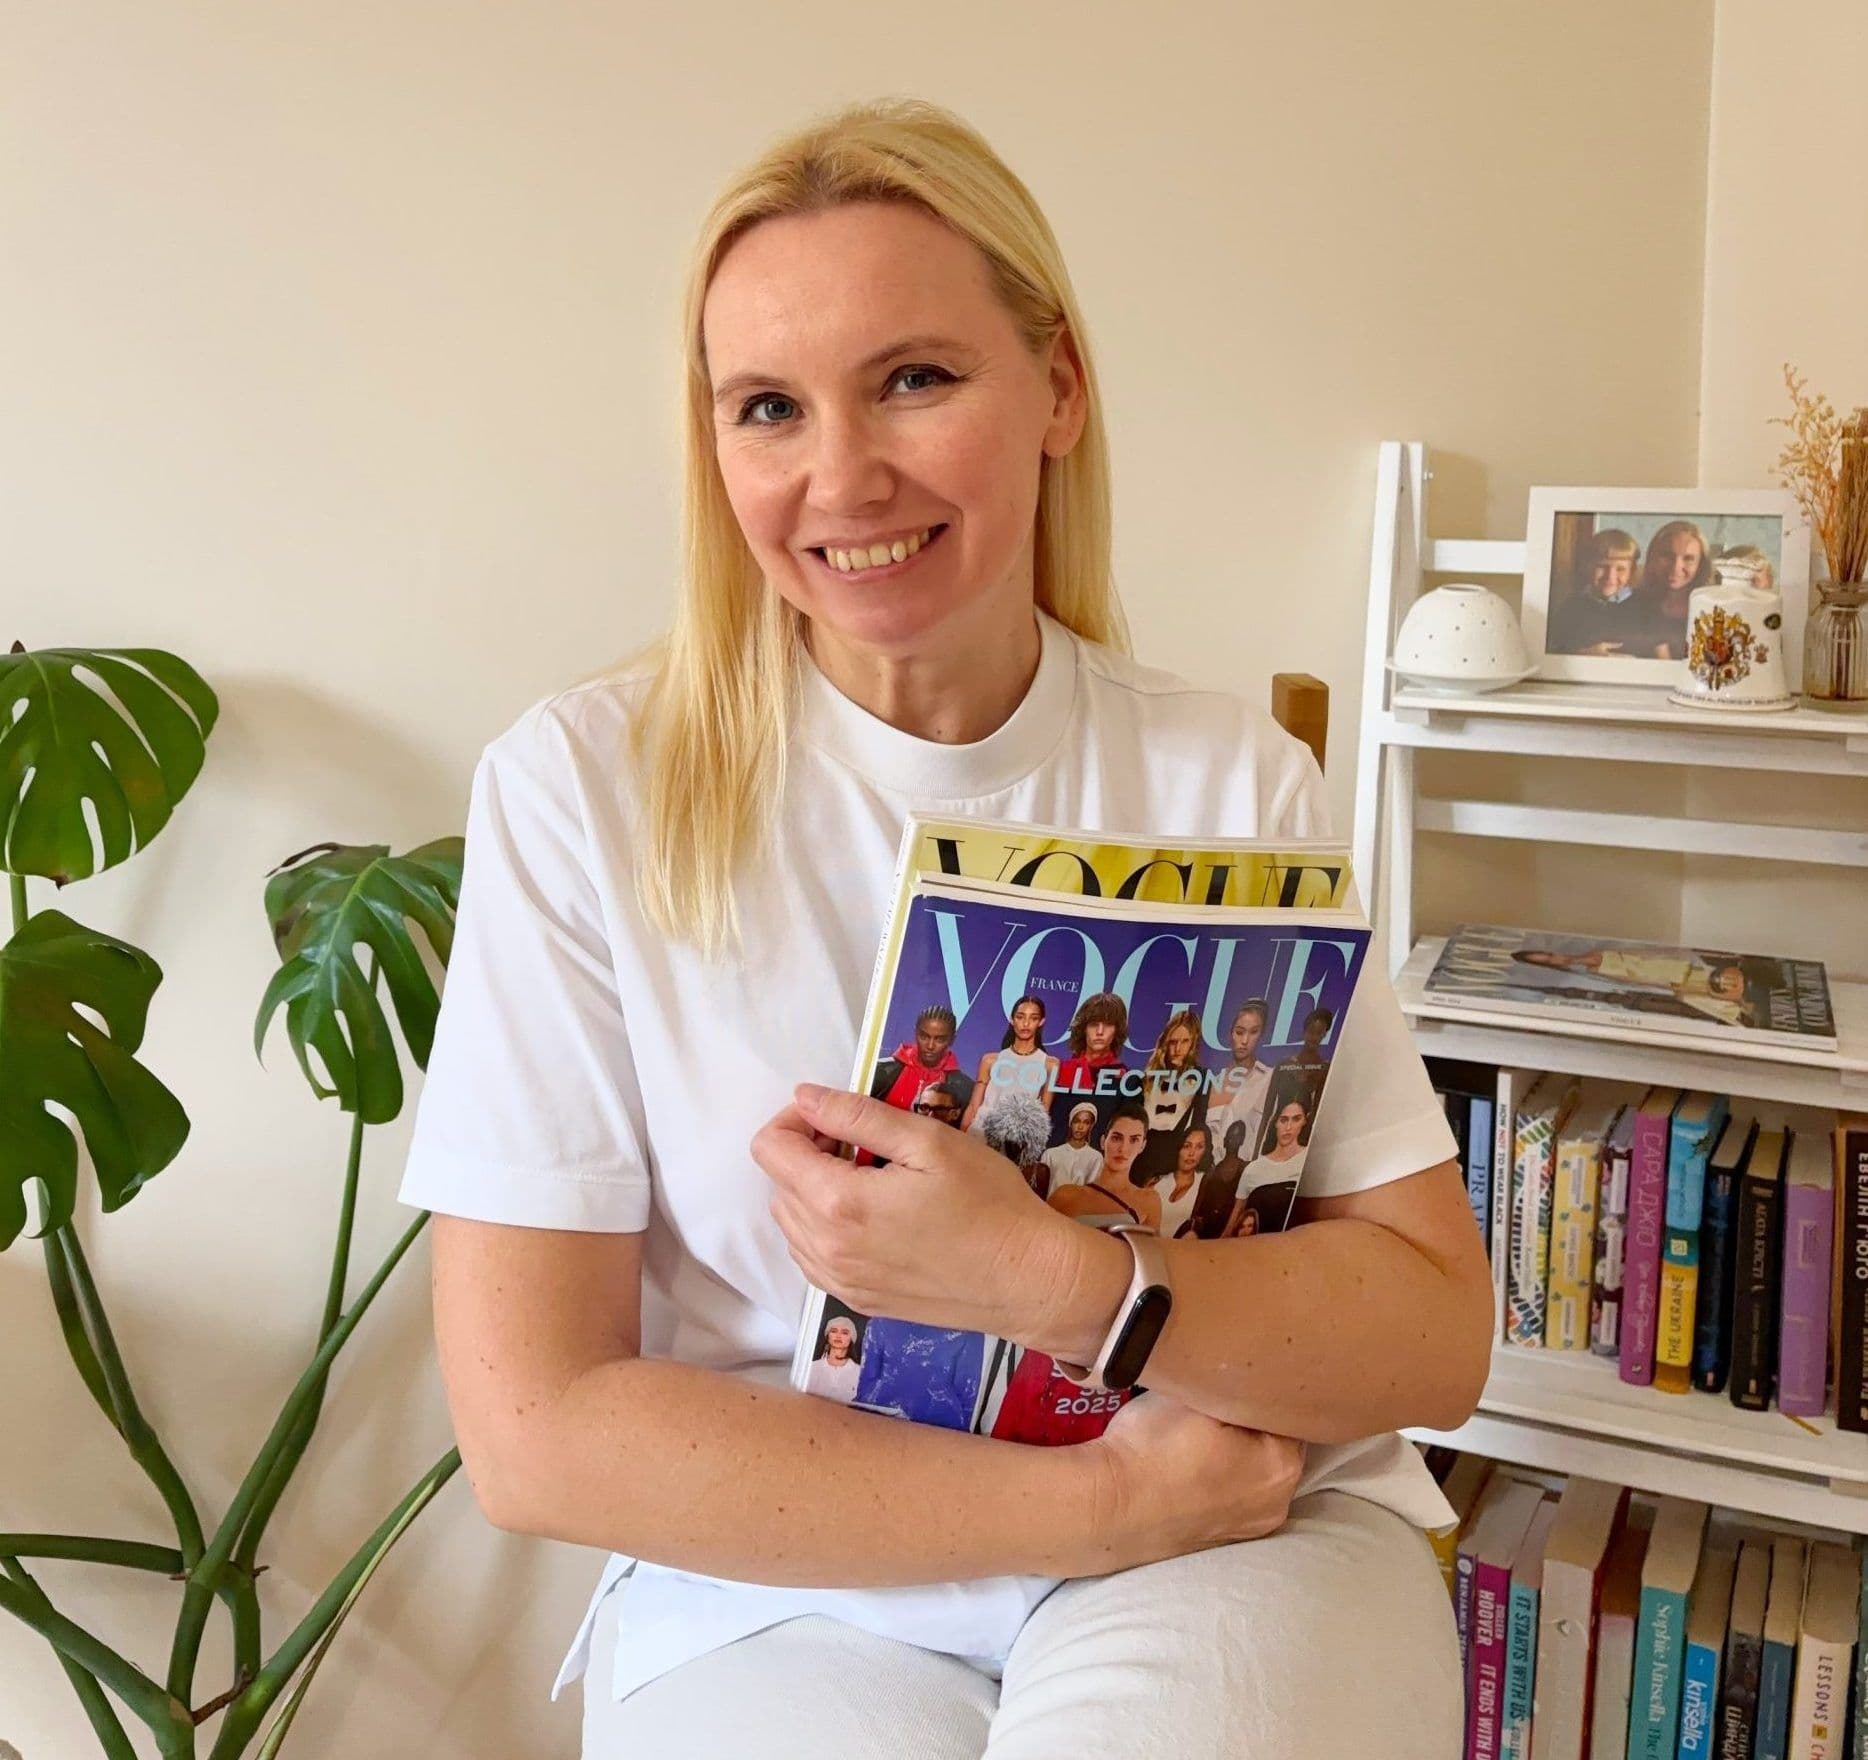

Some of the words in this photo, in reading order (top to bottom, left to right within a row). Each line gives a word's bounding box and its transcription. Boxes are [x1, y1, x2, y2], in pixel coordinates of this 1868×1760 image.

[924, 909, 1356, 1054] VOGUE
[1029, 976, 1080, 994] FRANCE
[990, 1058, 1250, 1097] COLLECTIONS
[1499, 1103, 1507, 1127] HOW
[1498, 1128, 1506, 1150] NOT
[1498, 1152, 1506, 1165] TO
[1641, 1131, 1664, 1186] САРА
[1497, 1167, 1505, 1195] WEAR
[1496, 1196, 1504, 1225] BLACK
[1667, 1337, 1681, 1362] THE
[1054, 1394, 1121, 1415] 2025
[1477, 1589, 1495, 1647] HOOVER
[1516, 1596, 1531, 1613] IT
[1514, 1614, 1530, 1661] STARTS
[1653, 1603, 1672, 1660] Sophie
[1481, 1663, 1496, 1678] IT
[1511, 1662, 1527, 1700] WITH
[1479, 1679, 1496, 1714] ENDS
[1649, 1663, 1668, 1723] Kinsella
[1816, 1655, 1834, 1721] LESSONS
[1509, 1700, 1524, 1722] US
[1681, 1679, 1704, 1751] kinsella
[1476, 1716, 1493, 1750] WITH
